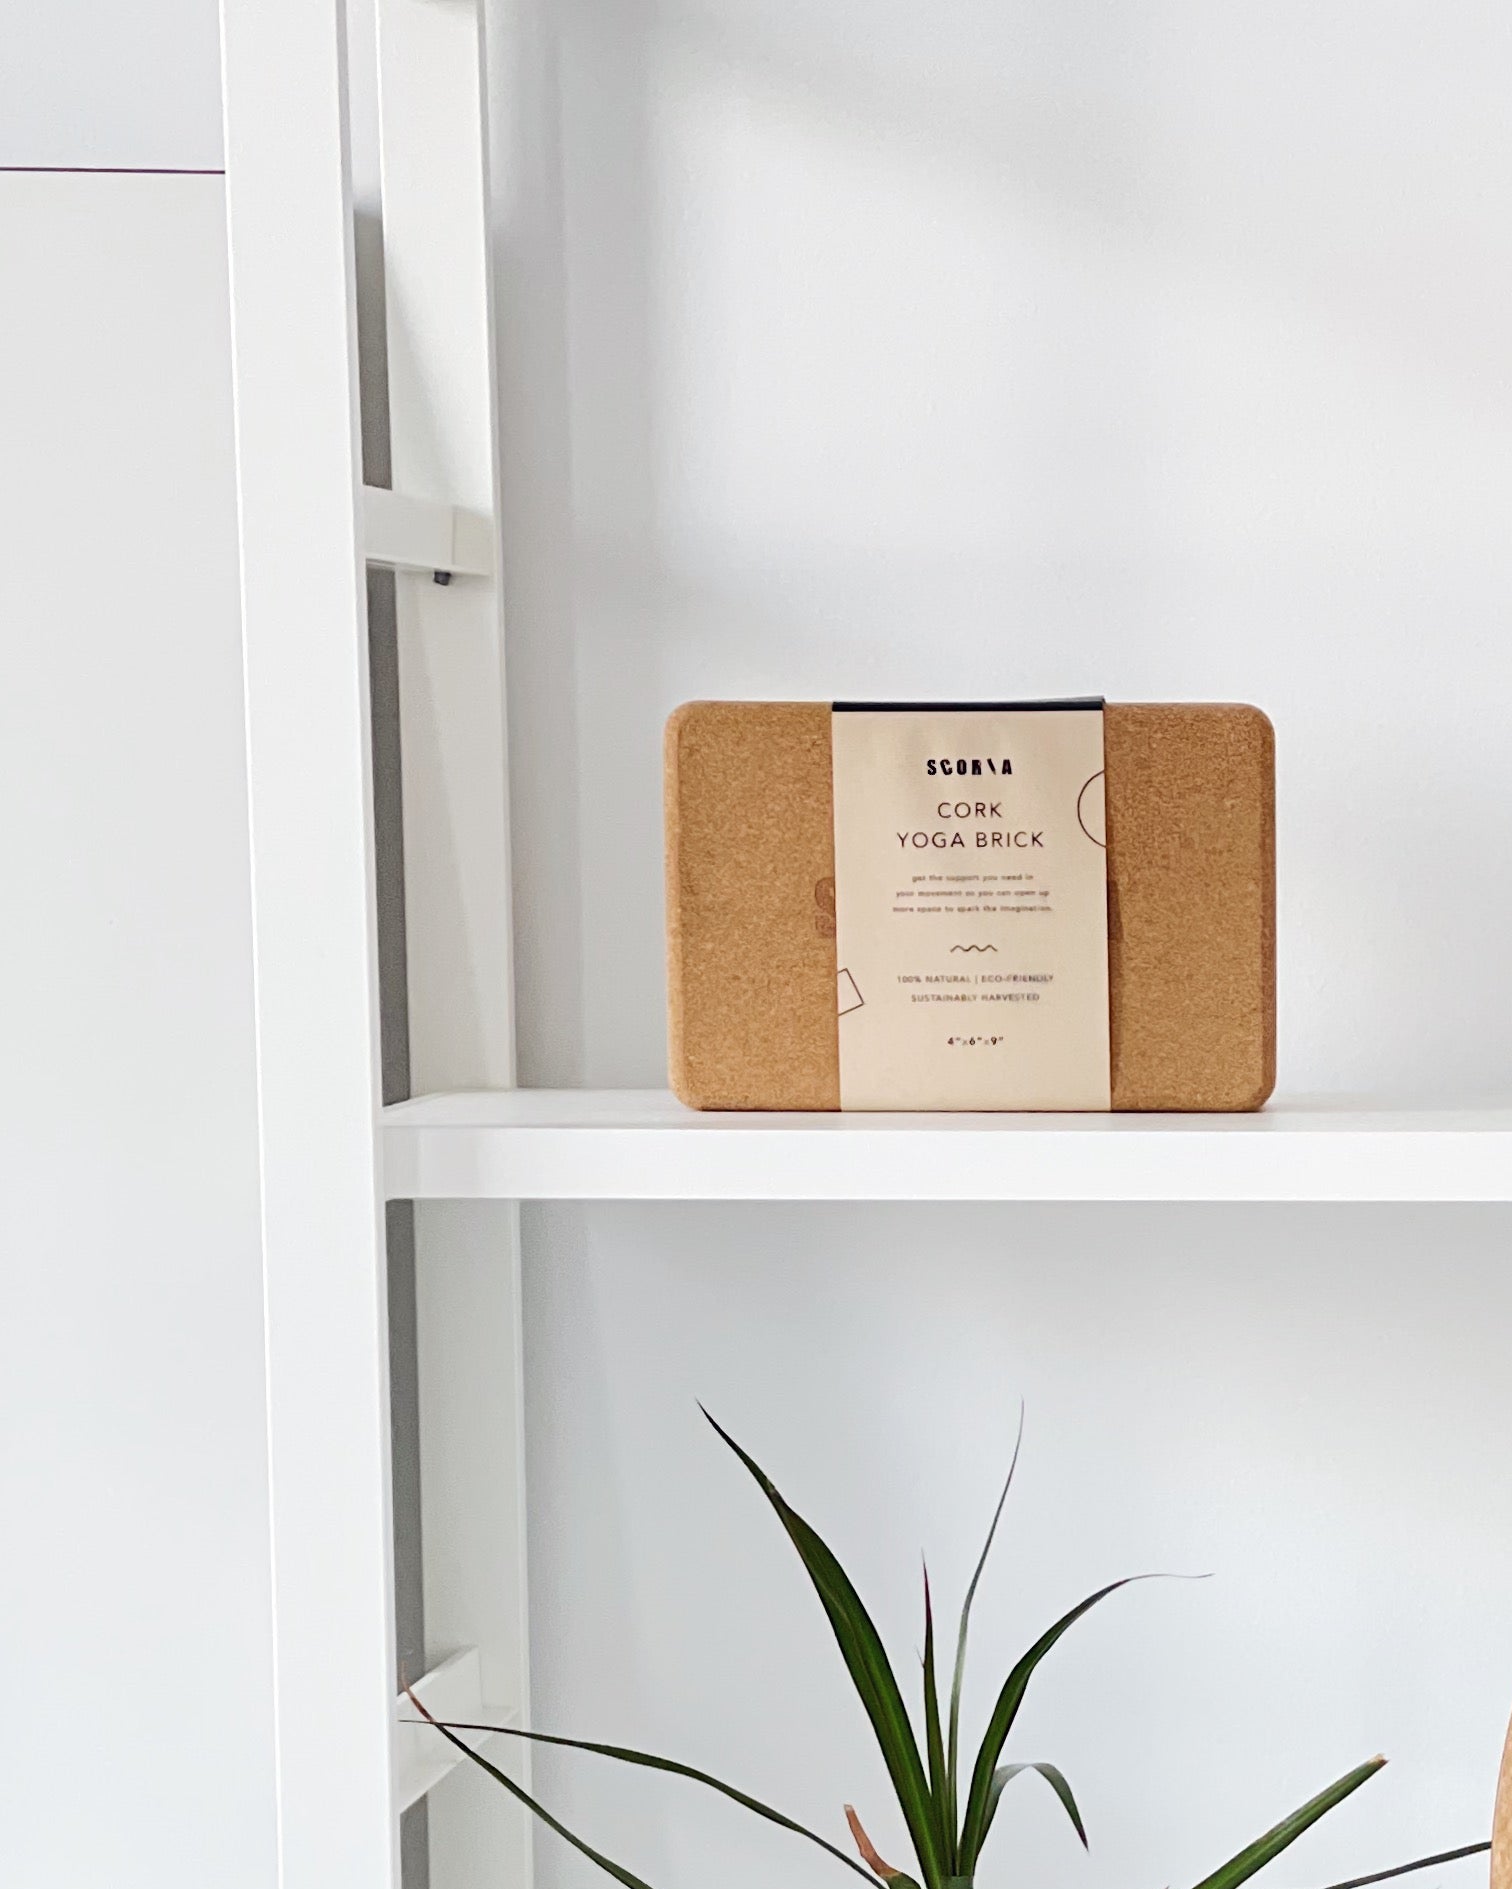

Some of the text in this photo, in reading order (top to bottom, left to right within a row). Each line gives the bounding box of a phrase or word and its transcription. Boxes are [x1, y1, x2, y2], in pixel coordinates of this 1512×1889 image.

[937, 802, 1003, 819] CORK
[896, 831, 1045, 849] YOGA BRICK
[946, 874, 979, 883] support
[983, 875, 998, 883] you
[897, 974, 1054, 984] 100% NATURAL ECO-FRIENDLY
[911, 993, 1040, 1003] SUSTAINABLY HARVESTED
